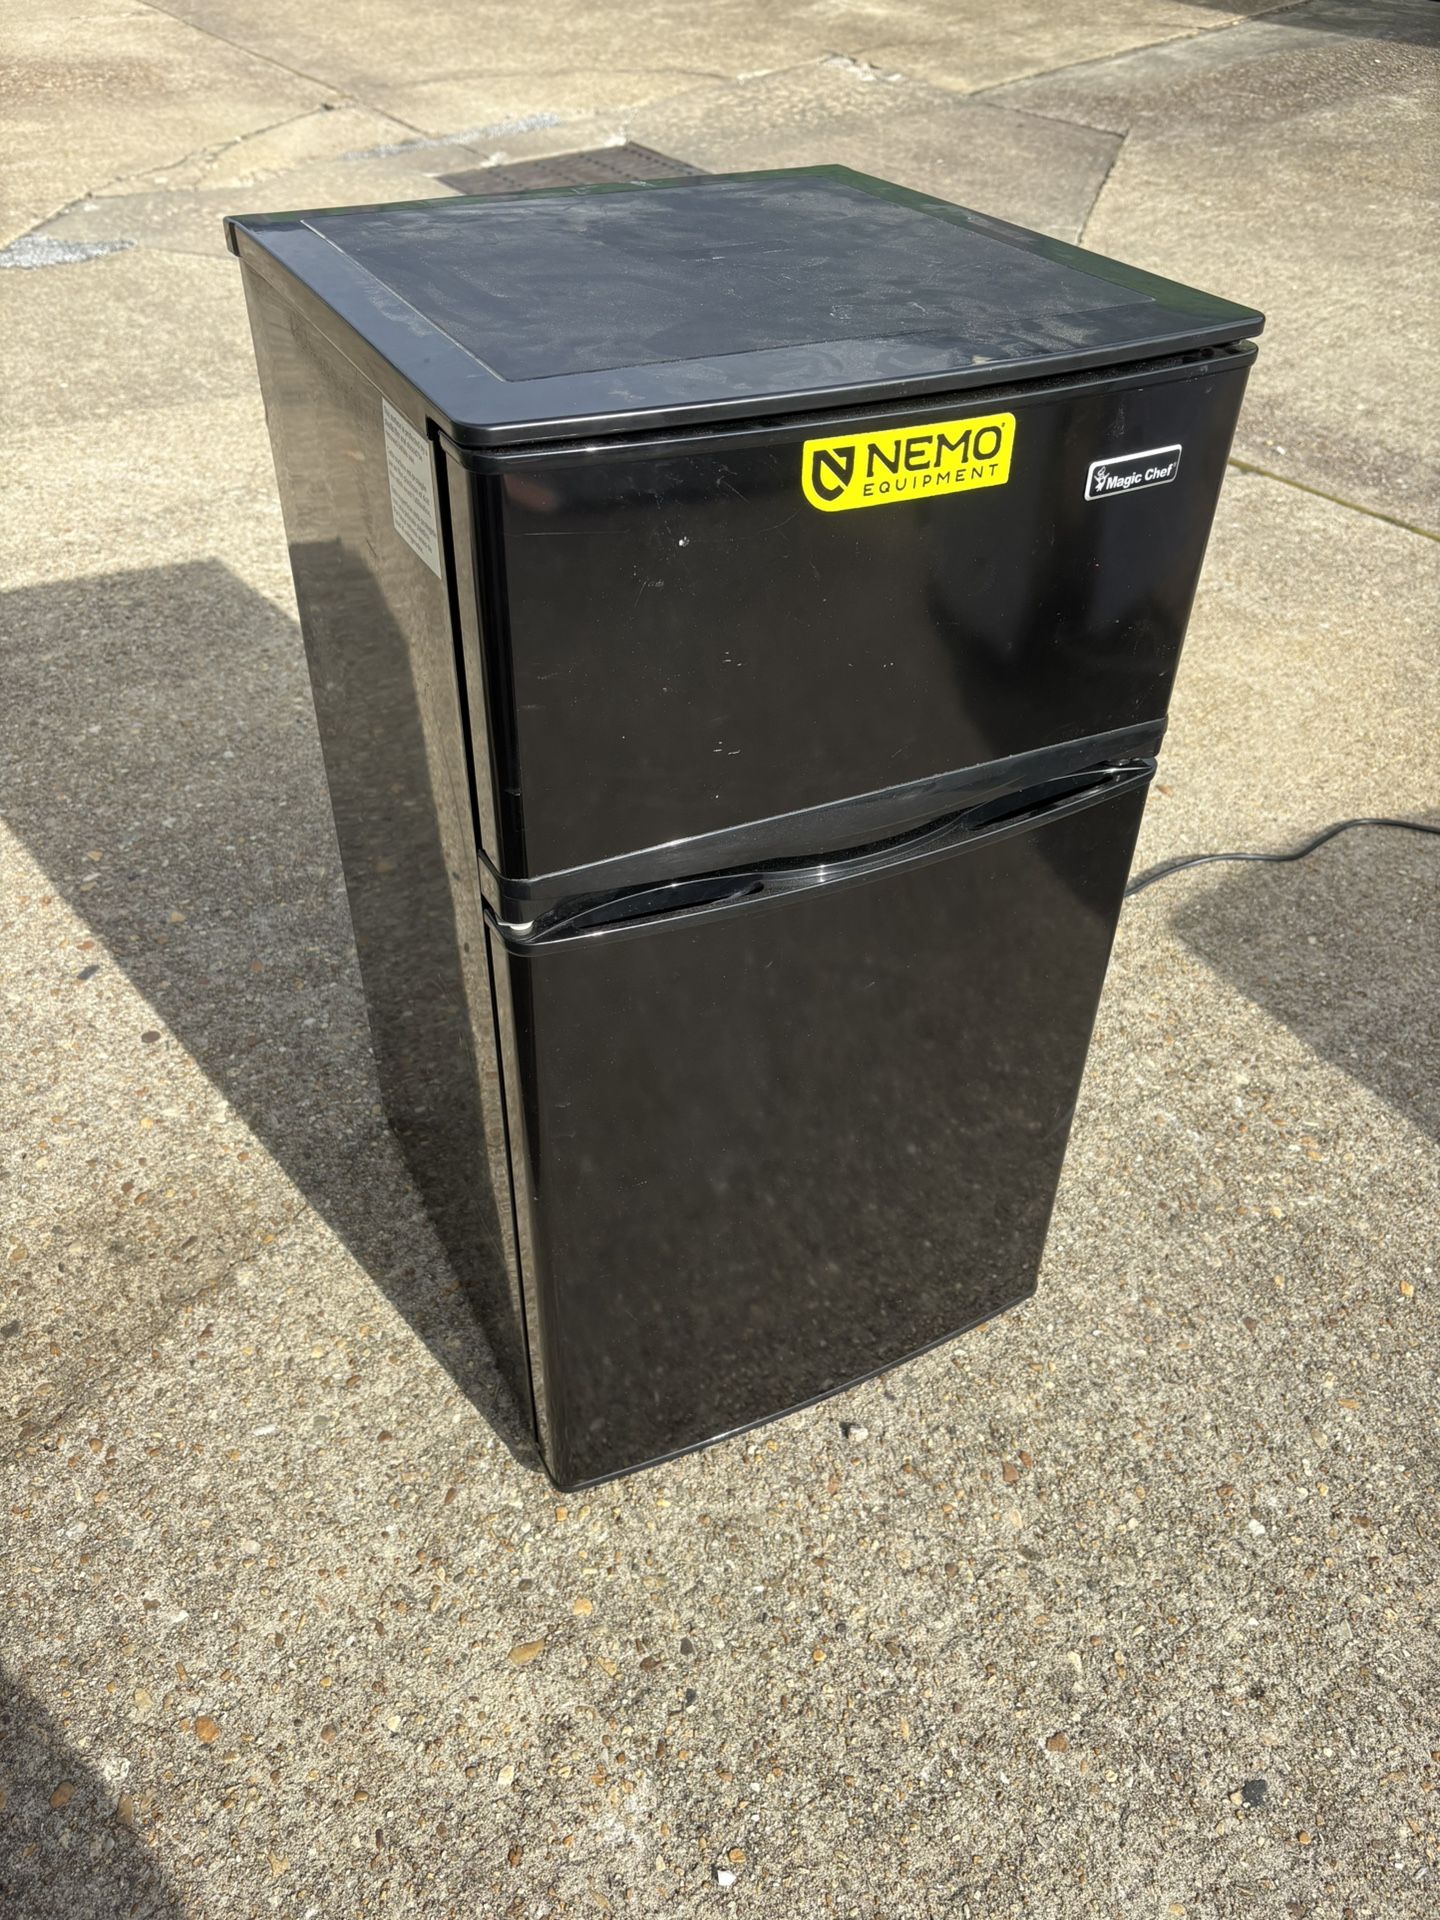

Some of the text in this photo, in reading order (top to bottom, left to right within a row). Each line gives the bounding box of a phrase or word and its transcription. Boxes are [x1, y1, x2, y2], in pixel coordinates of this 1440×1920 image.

[866, 425, 1002, 478] NEMO
[862, 463, 999, 496] EQUIPMENT
[1105, 463, 1174, 490] Magic Chef
